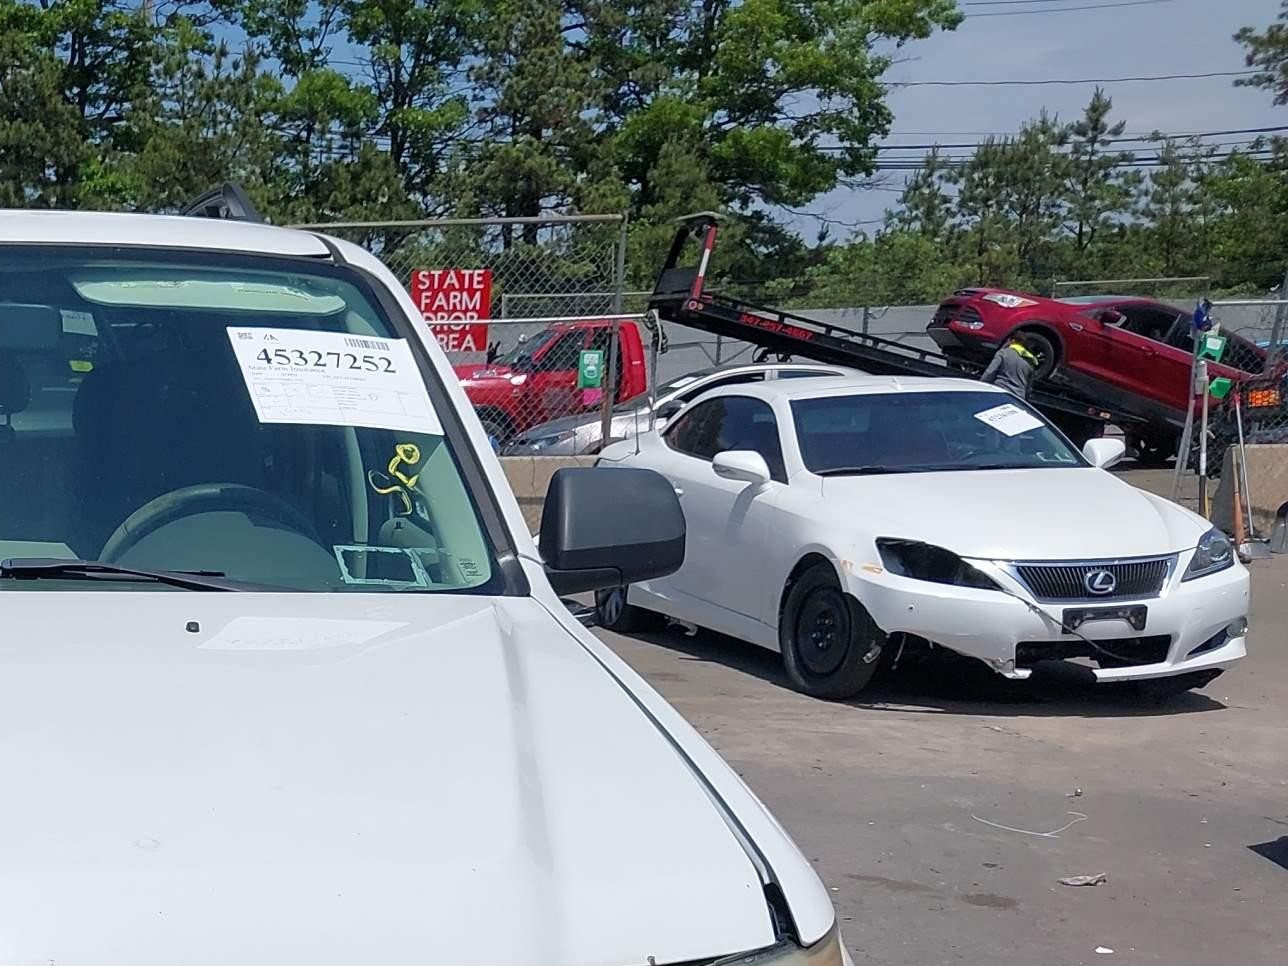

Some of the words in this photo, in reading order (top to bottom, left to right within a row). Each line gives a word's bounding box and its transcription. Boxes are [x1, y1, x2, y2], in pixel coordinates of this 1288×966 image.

[417, 269, 486, 290] STATE
[420, 291, 481, 311] FARM
[436, 333, 476, 353] REA
[256, 347, 397, 374] 45327252
